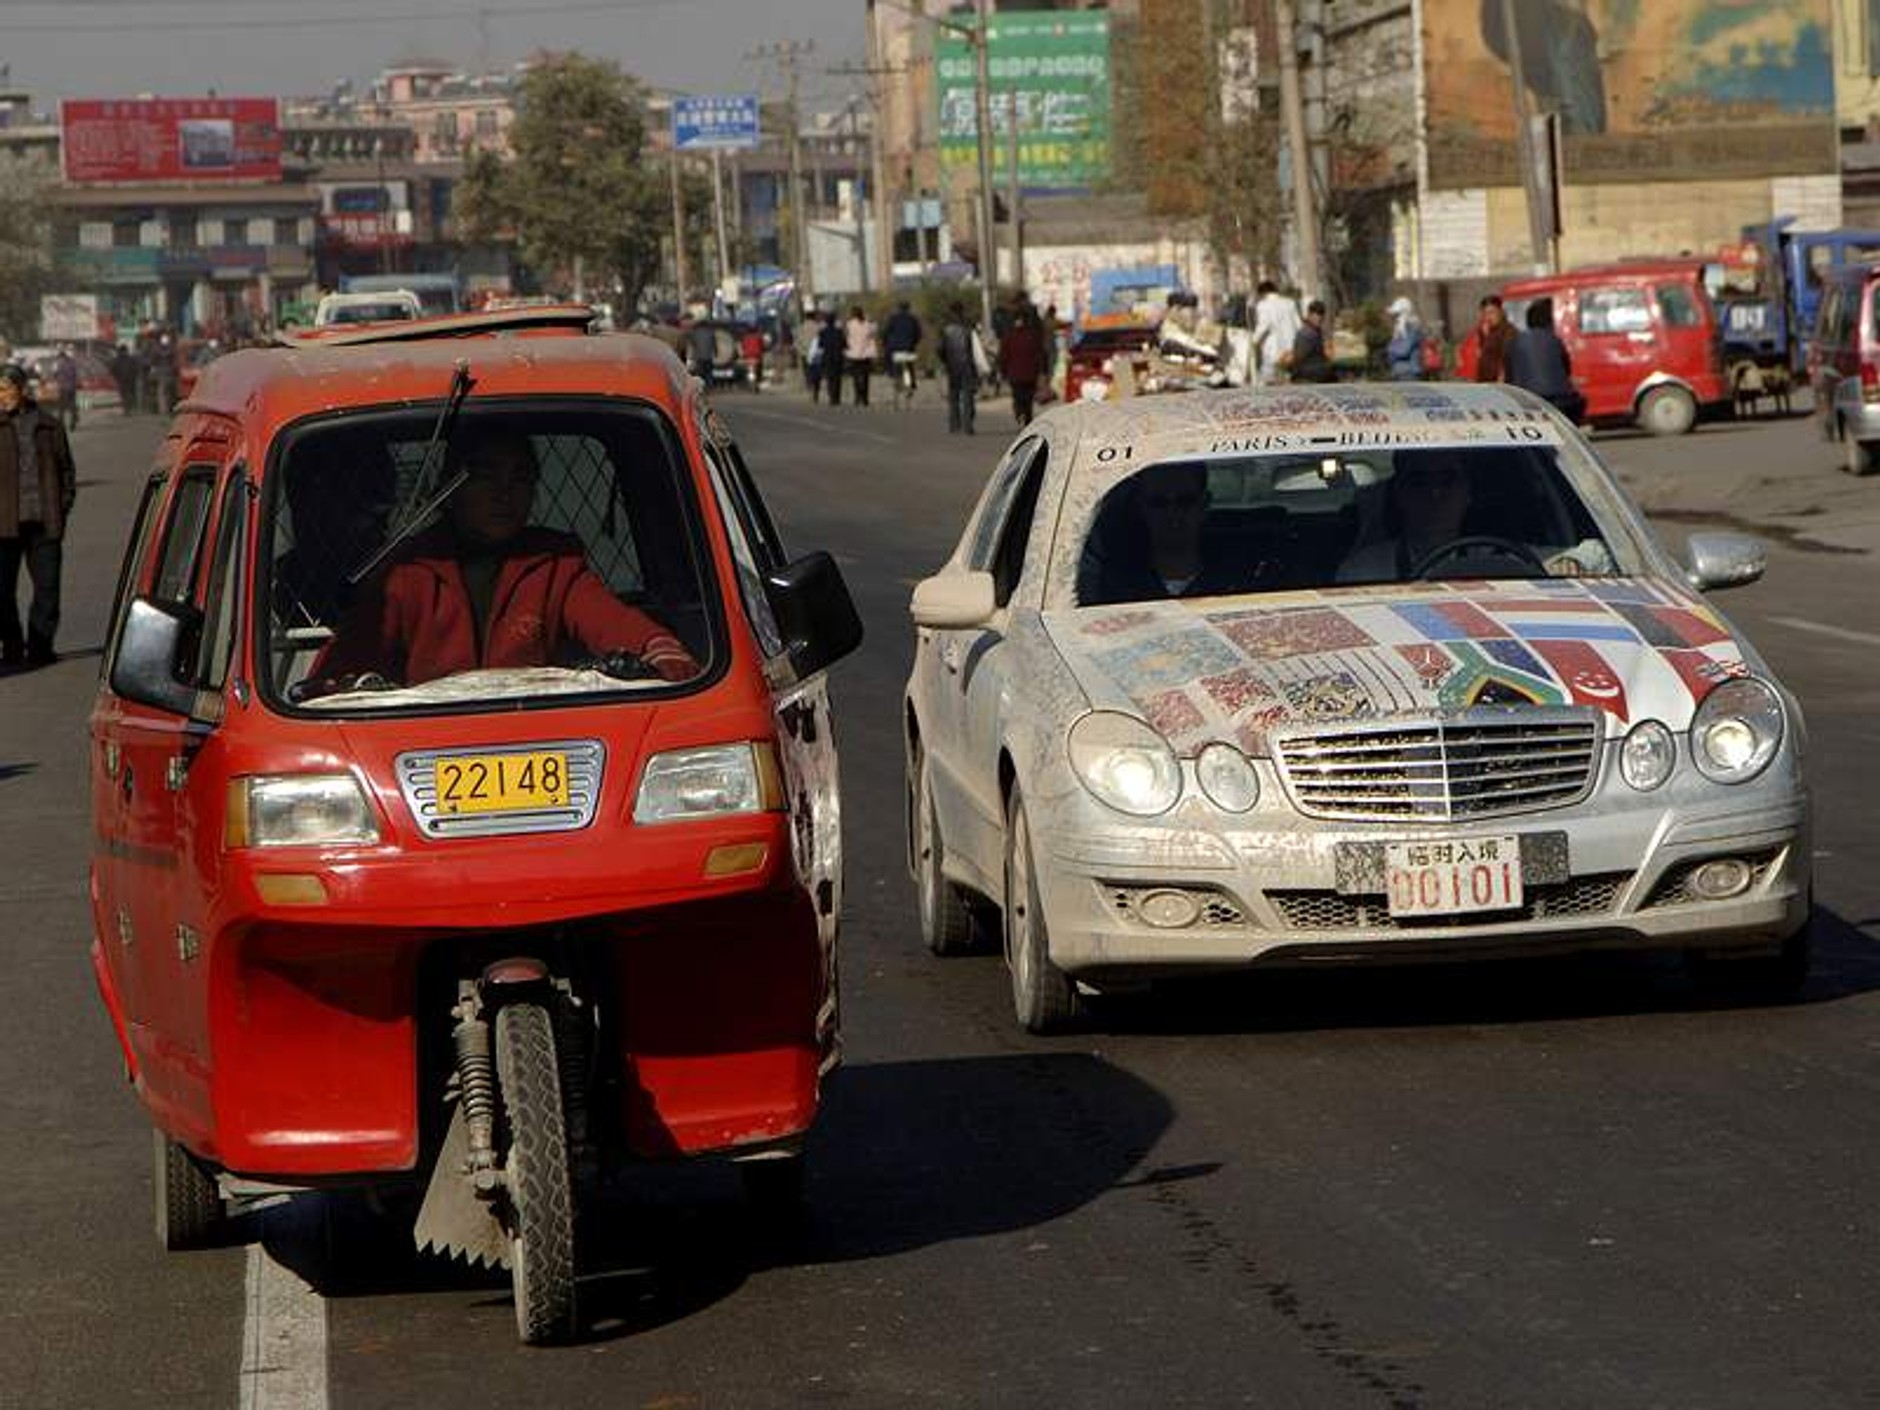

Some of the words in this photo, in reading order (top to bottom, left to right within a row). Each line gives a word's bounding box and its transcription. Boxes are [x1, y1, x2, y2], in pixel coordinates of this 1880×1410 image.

[1097, 446, 1132, 461] 01
[1210, 435, 1288, 452] PARIS
[443, 757, 561, 801] 22148
[1393, 862, 1512, 911] 00101
